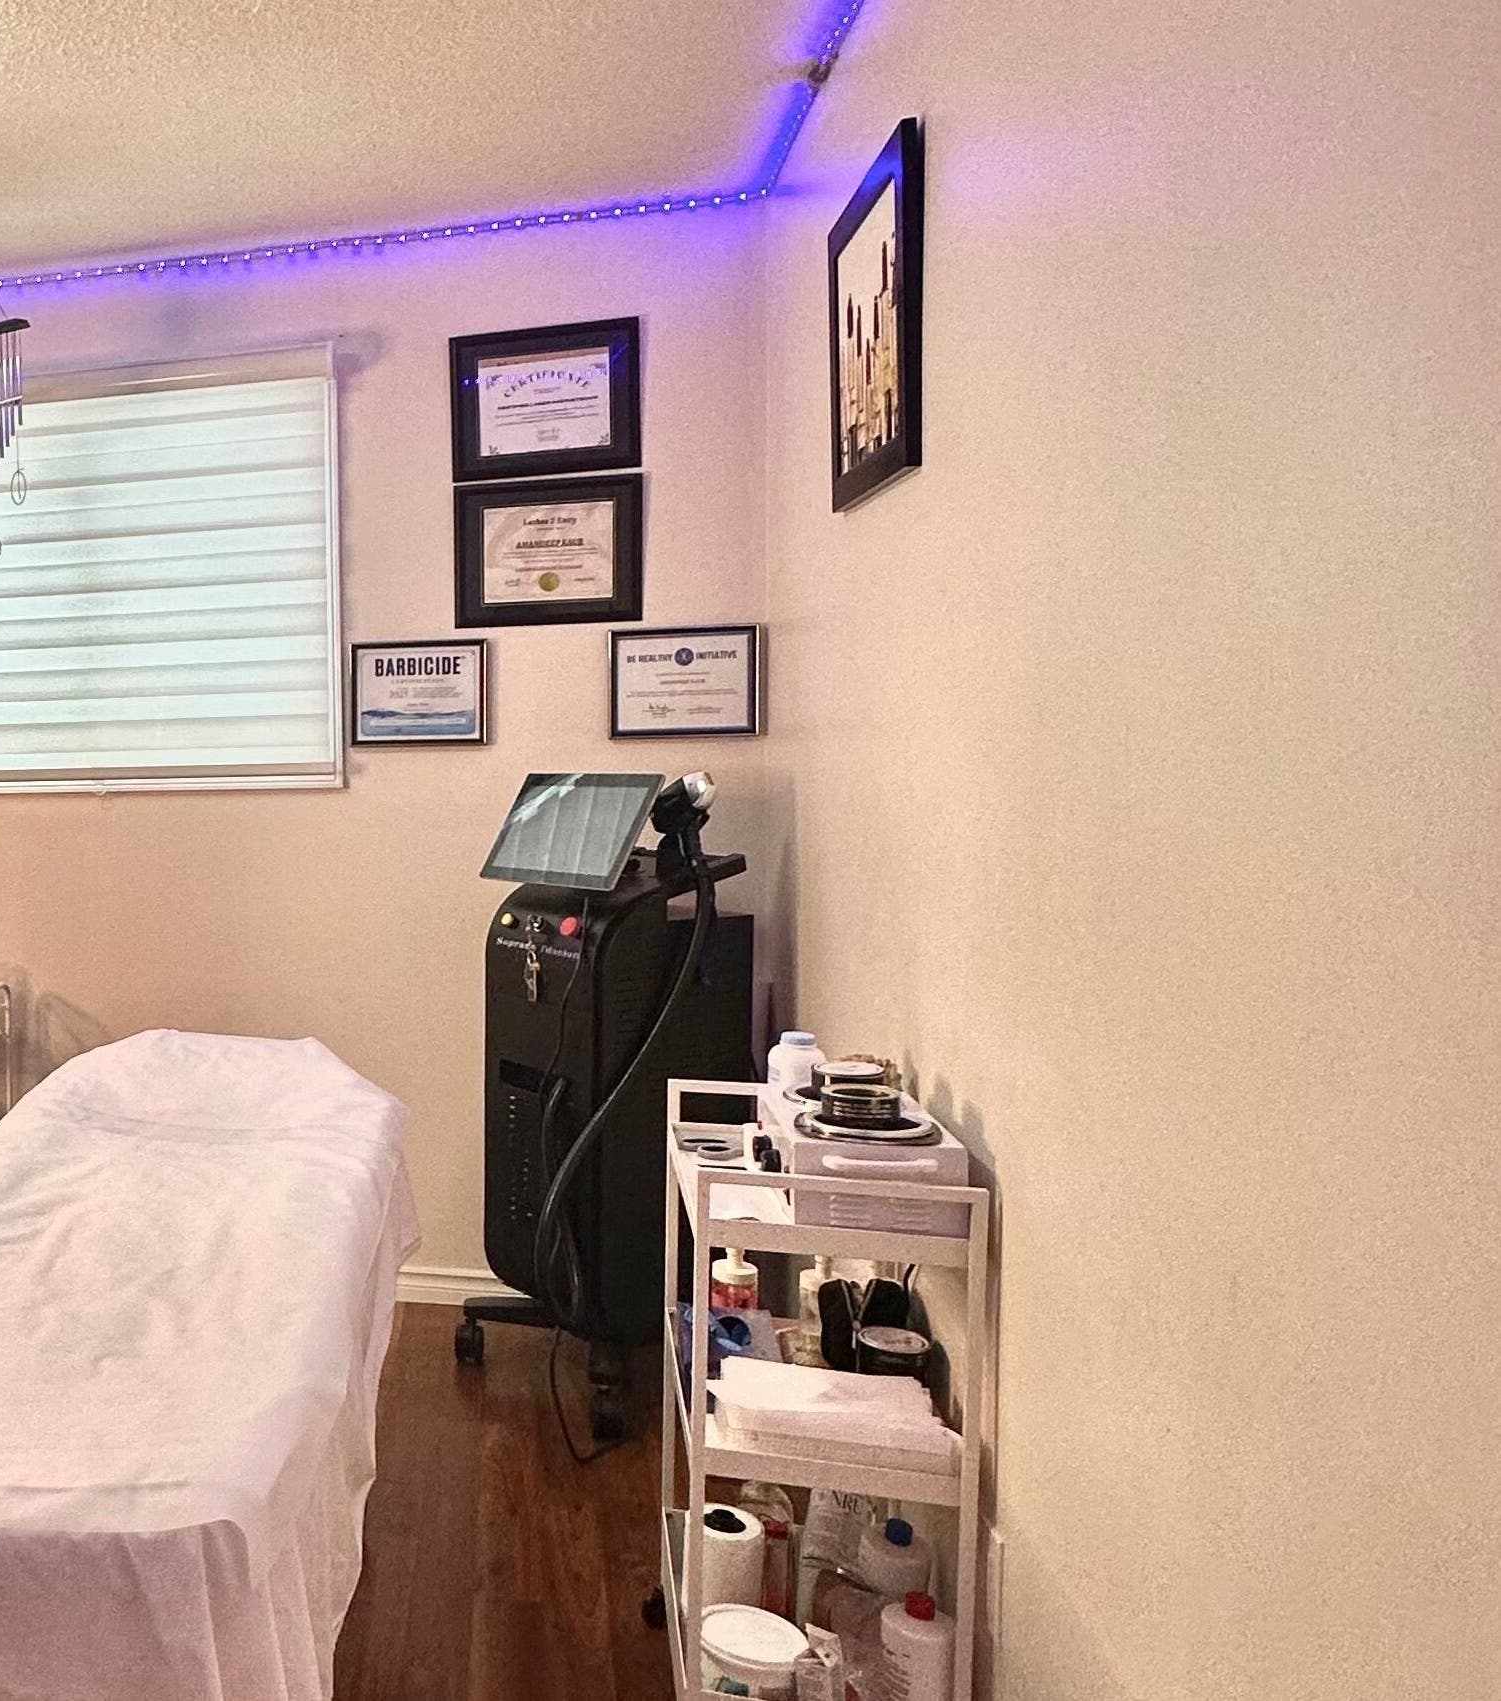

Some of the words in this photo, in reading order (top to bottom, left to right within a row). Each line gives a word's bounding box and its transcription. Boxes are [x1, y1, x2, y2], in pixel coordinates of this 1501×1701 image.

[626, 655, 636, 664] BE
[638, 653, 673, 663] HEALTHY
[695, 650, 738, 661] INITIATIVE
[374, 656, 461, 677] BARBICIDE
